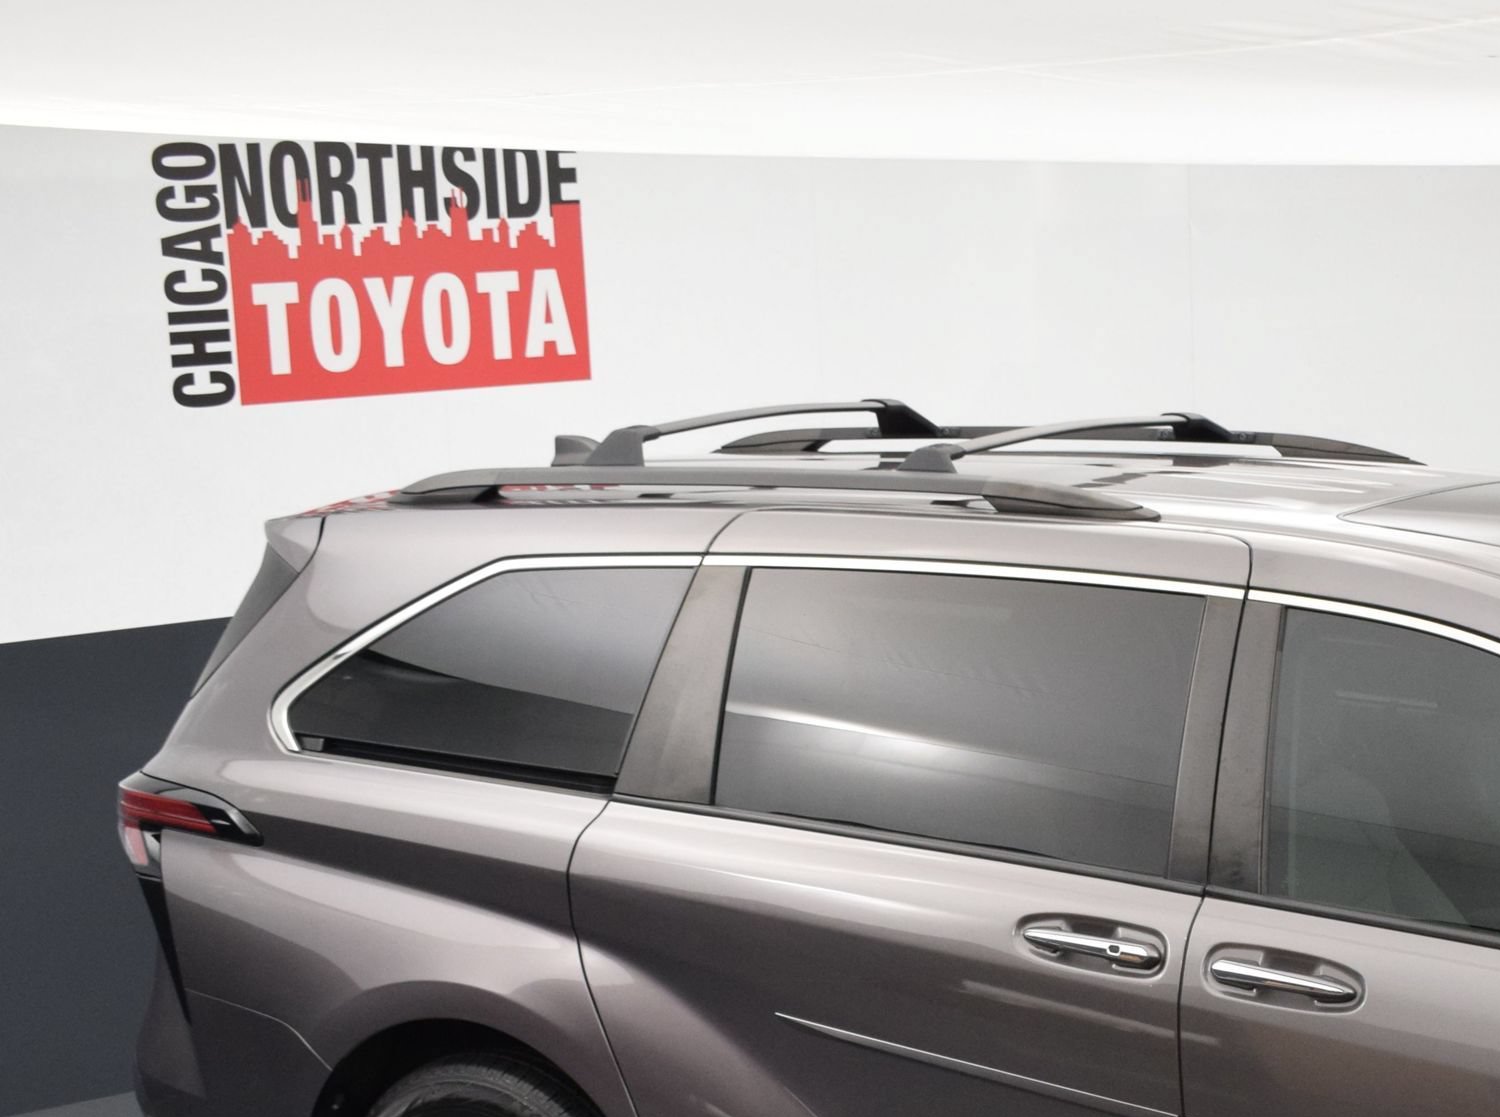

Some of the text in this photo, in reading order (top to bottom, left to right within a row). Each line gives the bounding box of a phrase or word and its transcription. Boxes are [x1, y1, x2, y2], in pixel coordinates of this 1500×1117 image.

[218, 141, 578, 228] NORTHSIDE
[151, 141, 236, 408] CHICAGO
[251, 268, 577, 376] TOYOTA
